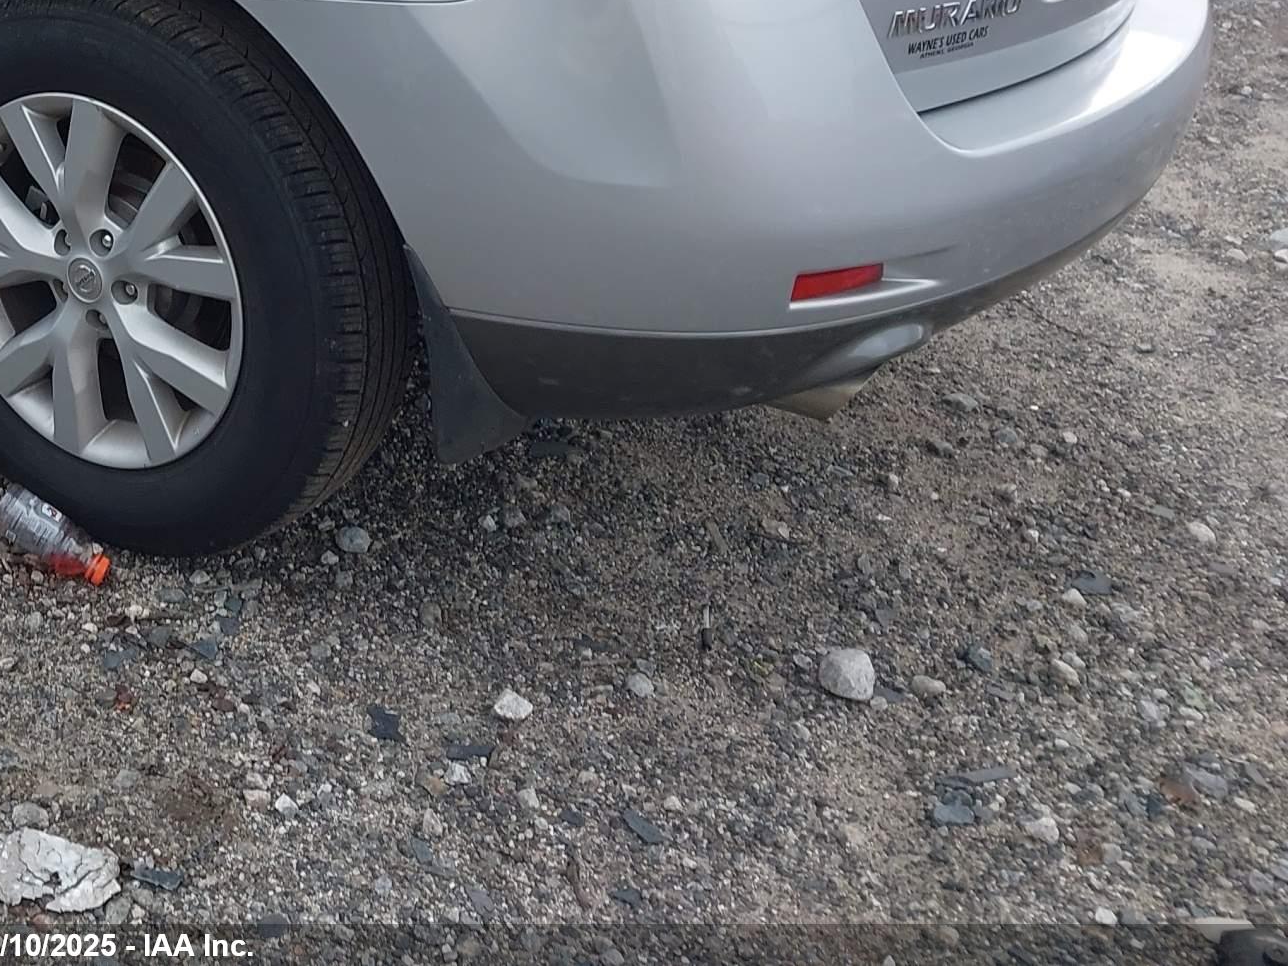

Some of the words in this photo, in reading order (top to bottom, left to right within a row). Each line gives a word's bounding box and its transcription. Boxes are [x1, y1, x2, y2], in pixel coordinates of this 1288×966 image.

[908, 36, 945, 55] WAYNE'S
[945, 31, 968, 46] USED
[969, 25, 989, 41] CARS
